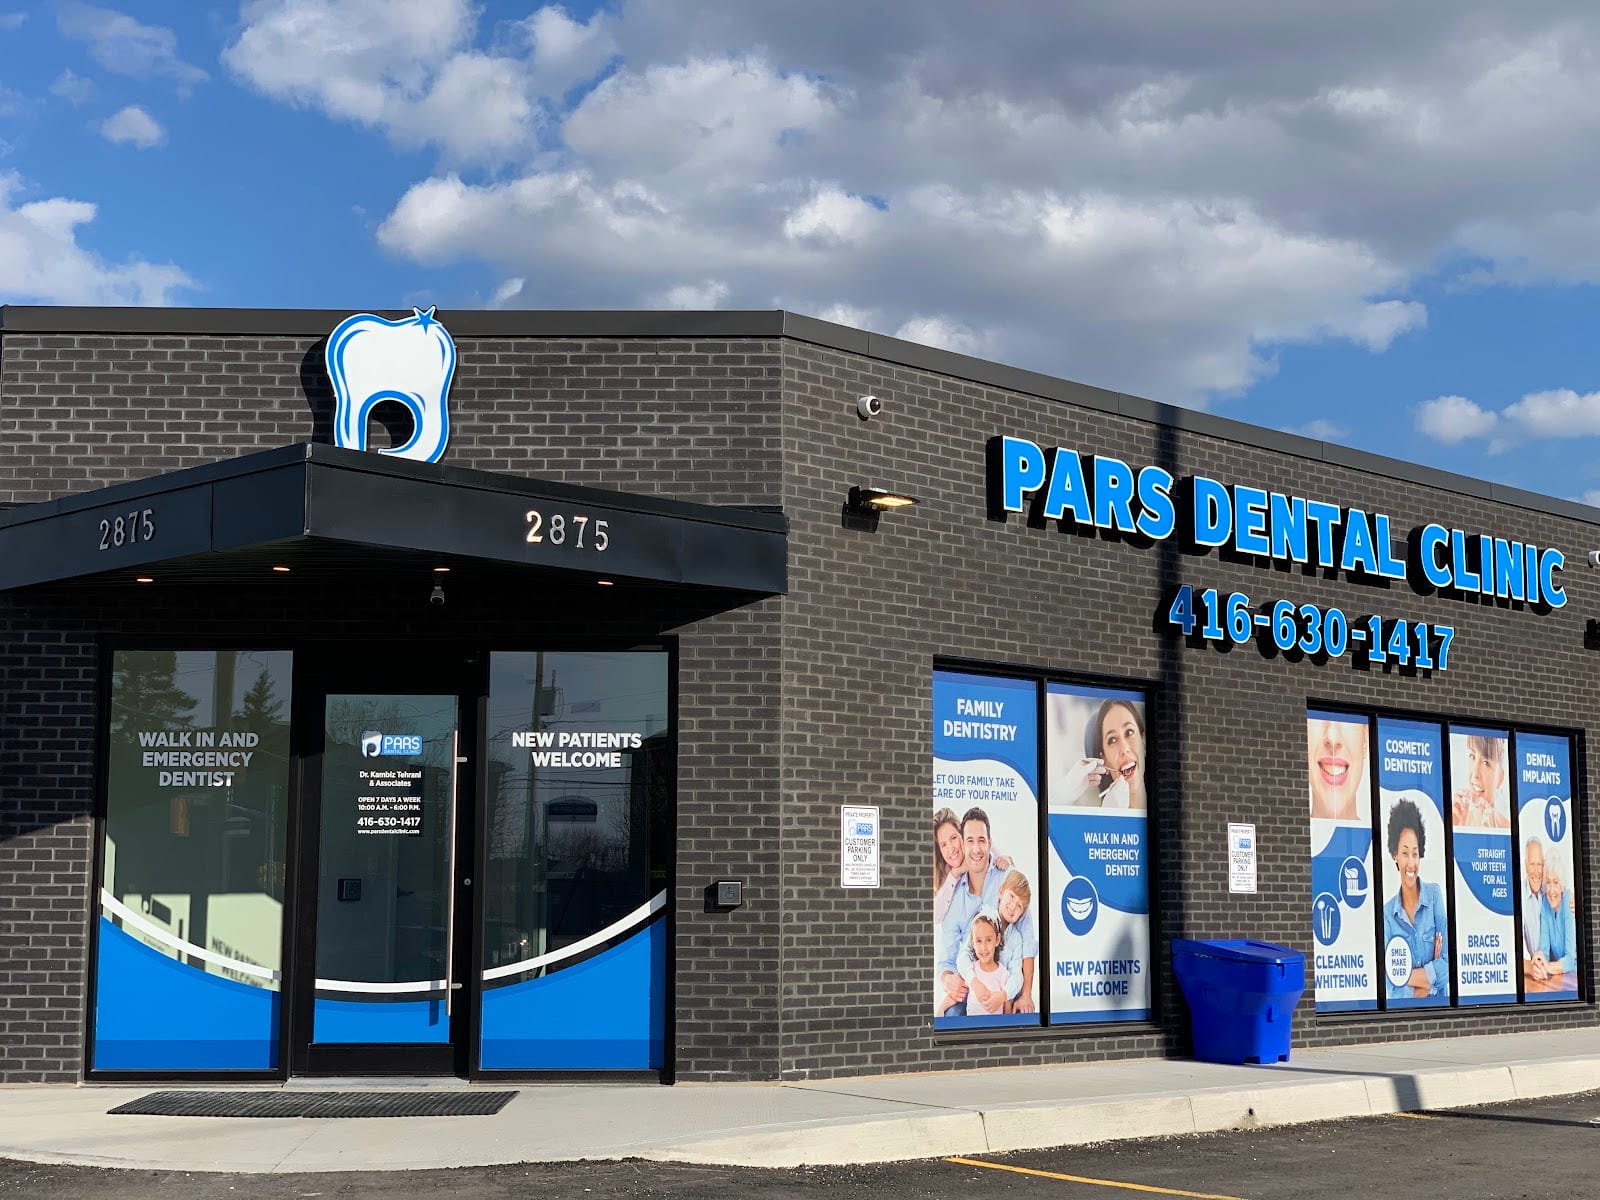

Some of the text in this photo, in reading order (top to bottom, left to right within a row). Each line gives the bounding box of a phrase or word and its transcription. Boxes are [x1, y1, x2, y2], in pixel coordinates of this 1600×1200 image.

[99, 509, 155, 550] 2875
[1002, 436, 1568, 608] PARS DENTAL CLINIC
[526, 510, 610, 551] 2875
[1169, 584, 1455, 671] 416-630-1417
[957, 698, 1004, 718] FAMILY
[943, 720, 1017, 742] DENTISTRY
[138, 732, 259, 747] WALK IN AND
[384, 736, 420, 750] PARS
[512, 732, 642, 748] NEW PATIENTS
[1385, 739, 1431, 757] COSMETIC
[142, 751, 254, 767] EMERGENCY
[532, 752, 621, 767] WELCOME
[1384, 757, 1433, 775] DENTISTRY
[1526, 753, 1556, 768] DENTAL
[159, 771, 235, 787] DENTIST
[948, 775, 965, 785] OUR
[967, 776, 994, 786] FAMILY
[996, 777, 1015, 788] TAKE
[1522, 769, 1561, 785] IMPLANTS
[955, 789, 966, 799] OF
[968, 789, 989, 800] YOUR
[991, 790, 1018, 801] FAMILY
[357, 817, 421, 826] 416-630-1417
[845, 838, 876, 847] CUSTOMER
[1084, 832, 1139, 845] WALK IN AND
[847, 846, 872, 855] PARKING
[853, 854, 868, 862] ONLY
[1088, 849, 1140, 861] EMERGENCY
[1477, 849, 1506, 859] STRAIGHT
[1105, 864, 1140, 876] DENTIST
[1471, 862, 1506, 872] YOUR TEETH
[1483, 875, 1507, 885] FOR ALL
[1492, 887, 1507, 898] AGES
[1467, 934, 1500, 948] BRACES
[1391, 948, 1407, 957] SMILE
[1461, 952, 1507, 967] INVISALIGN
[1056, 959, 1141, 977] NEW PATIENTS
[1315, 954, 1364, 969] CLEANING
[1391, 958, 1407, 967] MAKE
[1392, 968, 1407, 977] OVER
[1461, 970, 1508, 985] SURE SMILE
[1070, 980, 1128, 997] WELCOME
